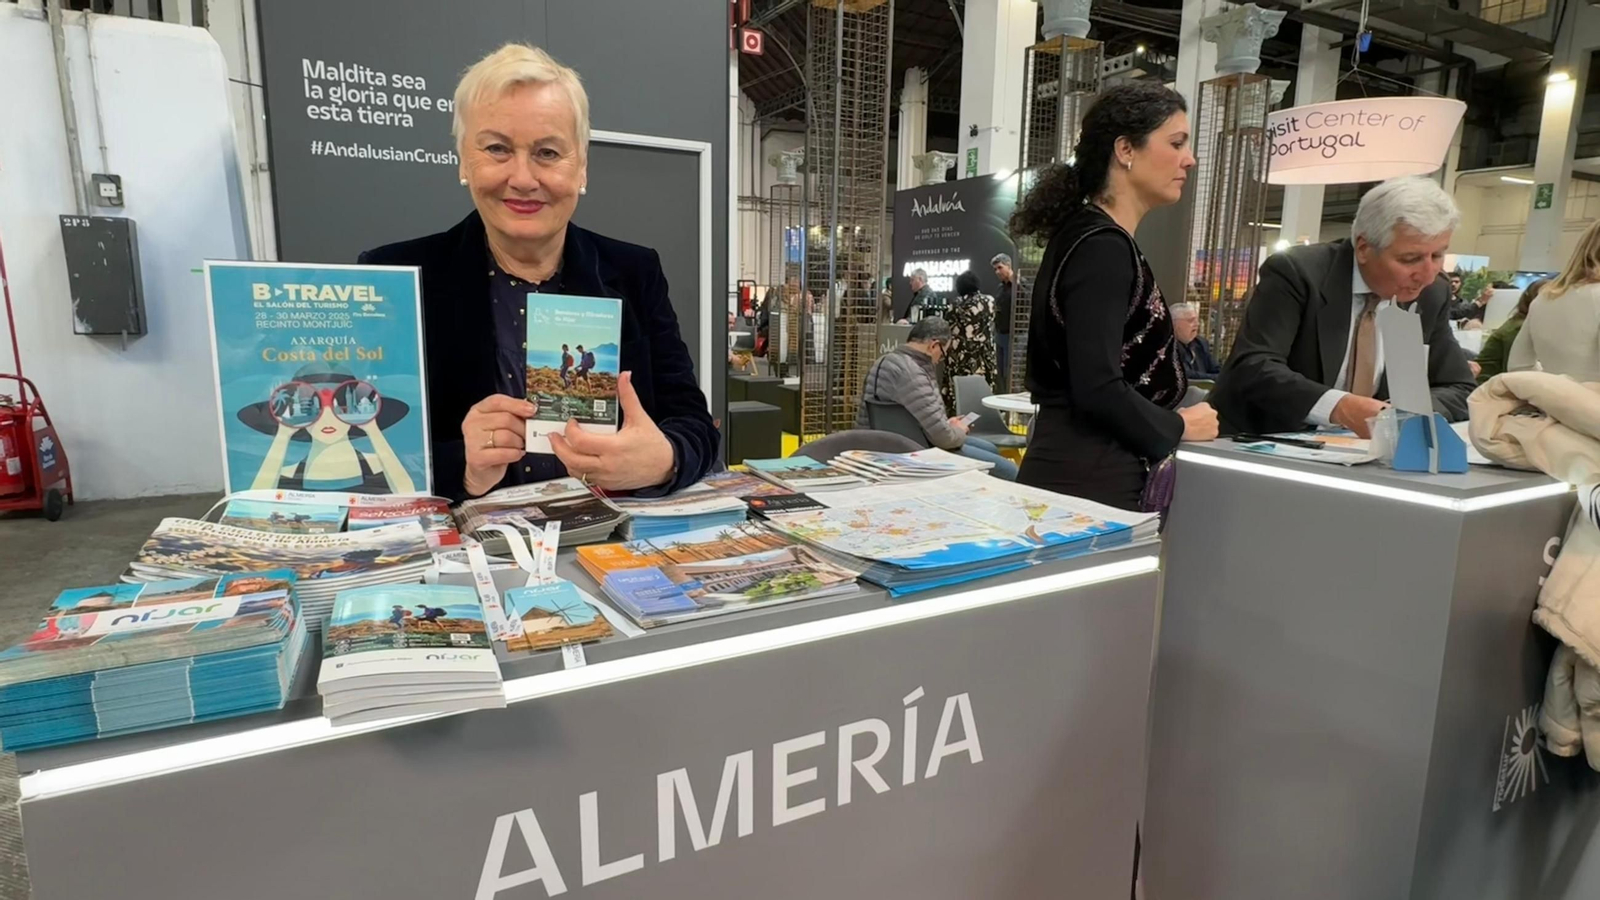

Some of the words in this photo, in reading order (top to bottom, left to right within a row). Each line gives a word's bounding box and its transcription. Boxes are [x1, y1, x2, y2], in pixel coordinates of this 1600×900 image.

[302, 58, 387, 86] Maldita
[392, 73, 426, 91] sea
[304, 78, 324, 99] la
[329, 82, 388, 106] gloria
[393, 93, 432, 112] que
[306, 102, 353, 122] esta
[357, 106, 414, 127] tierra
[1305, 109, 1394, 130] Center
[1398, 114, 1426, 132] of
[310, 140, 459, 165] #AndalusianCrush
[911, 191, 966, 217] Andalucía
[255, 312, 267, 320] 28
[278, 312, 289, 320] 30
[290, 312, 326, 320] MARZO
[329, 312, 350, 320] 2025
[266, 301, 295, 309] SALÓN
[256, 320, 300, 329] RECINTO
[290, 335, 357, 346] AXARQUÍA
[262, 347, 316, 362] Costa
[322, 346, 349, 361] del
[356, 346, 384, 361] Sol
[474, 686, 984, 900] ALMERÍA
